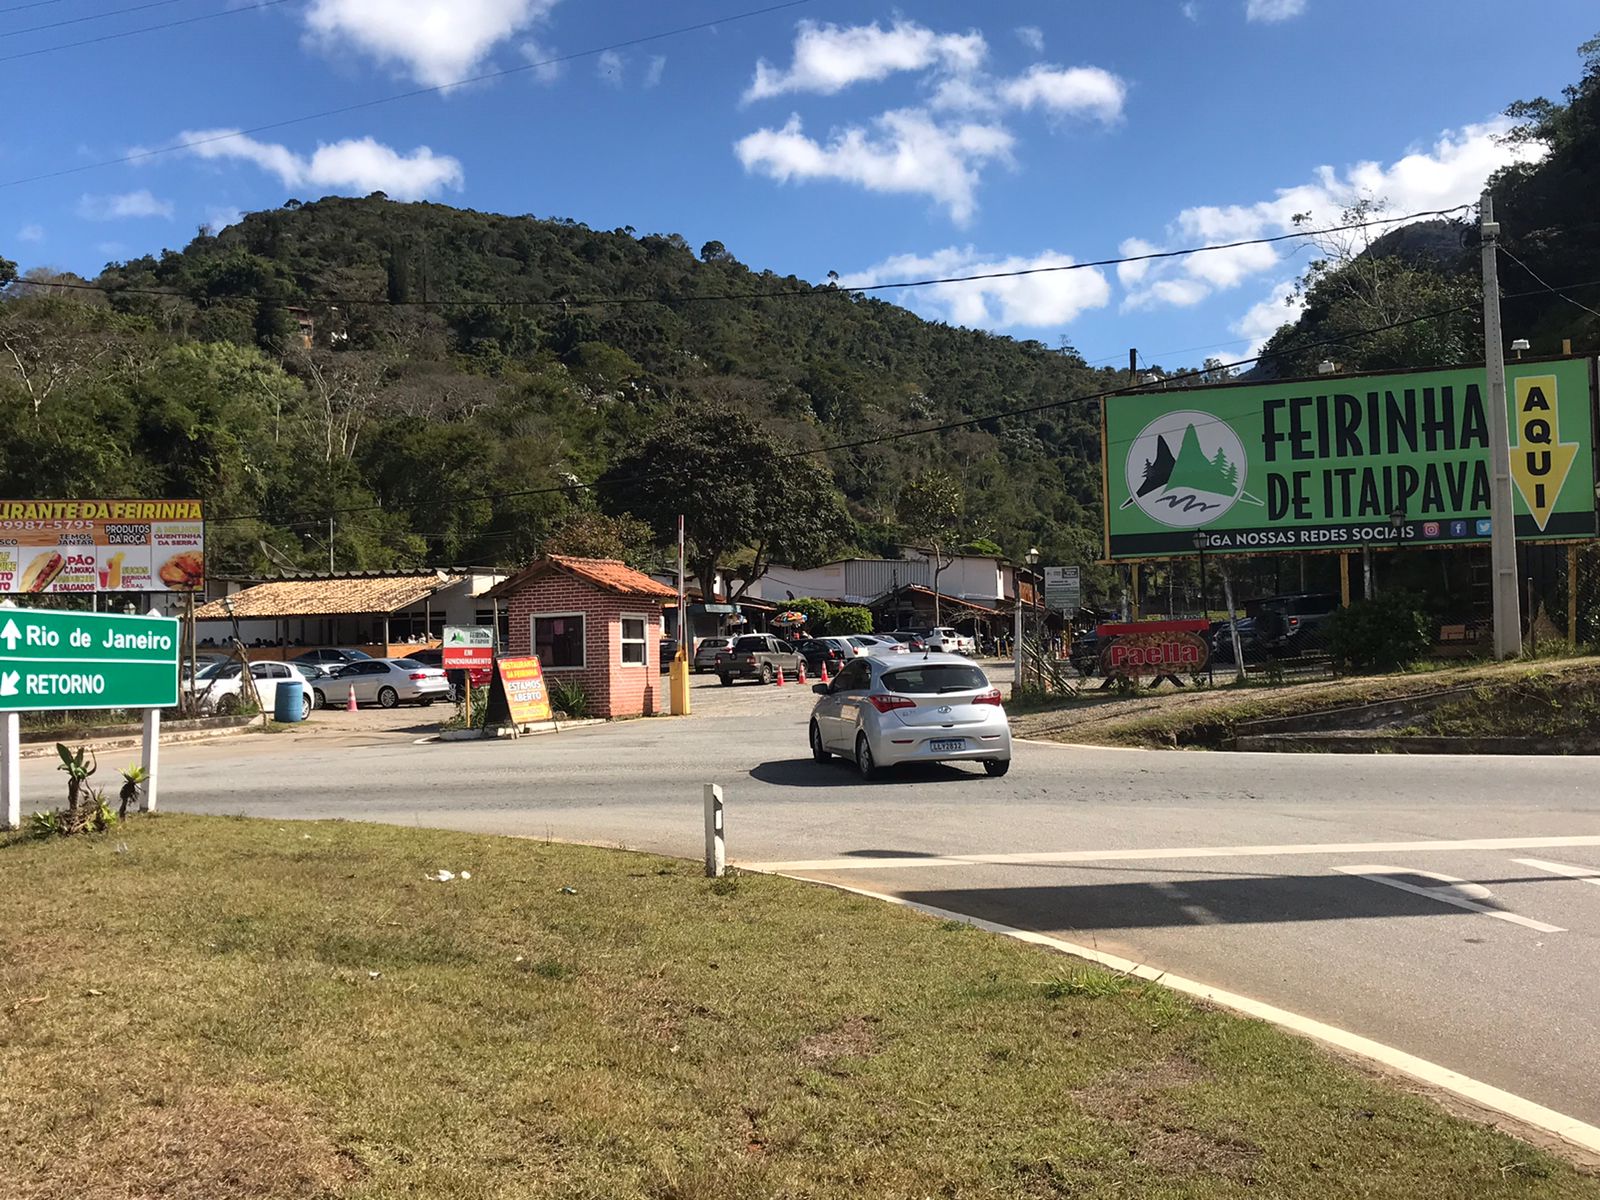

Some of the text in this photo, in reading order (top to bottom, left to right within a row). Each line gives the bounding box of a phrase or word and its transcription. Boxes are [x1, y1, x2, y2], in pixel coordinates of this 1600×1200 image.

[1262, 384, 1490, 462] FEIRINHA
[1523, 386, 1553, 509] AQUI
[1266, 460, 1492, 521] DE ITAIPAVA
[83, 503, 109, 519] DA
[113, 503, 202, 519] FEIRINHA
[0, 520, 94, 529] 9987-5795
[105, 524, 151, 534] PRODUTOS
[109, 535, 147, 544] DA ROÇA
[1206, 526, 1415, 546] IGA NOSSAS REDES SOCIAIS
[66, 554, 95, 566] PÃO
[26, 625, 171, 650] Rio de Janeiro
[1111, 642, 1199, 666] Paella
[26, 674, 105, 695] RETORNO
[508, 679, 541, 690] ESTAMOS
[513, 691, 542, 702] ABERTO
